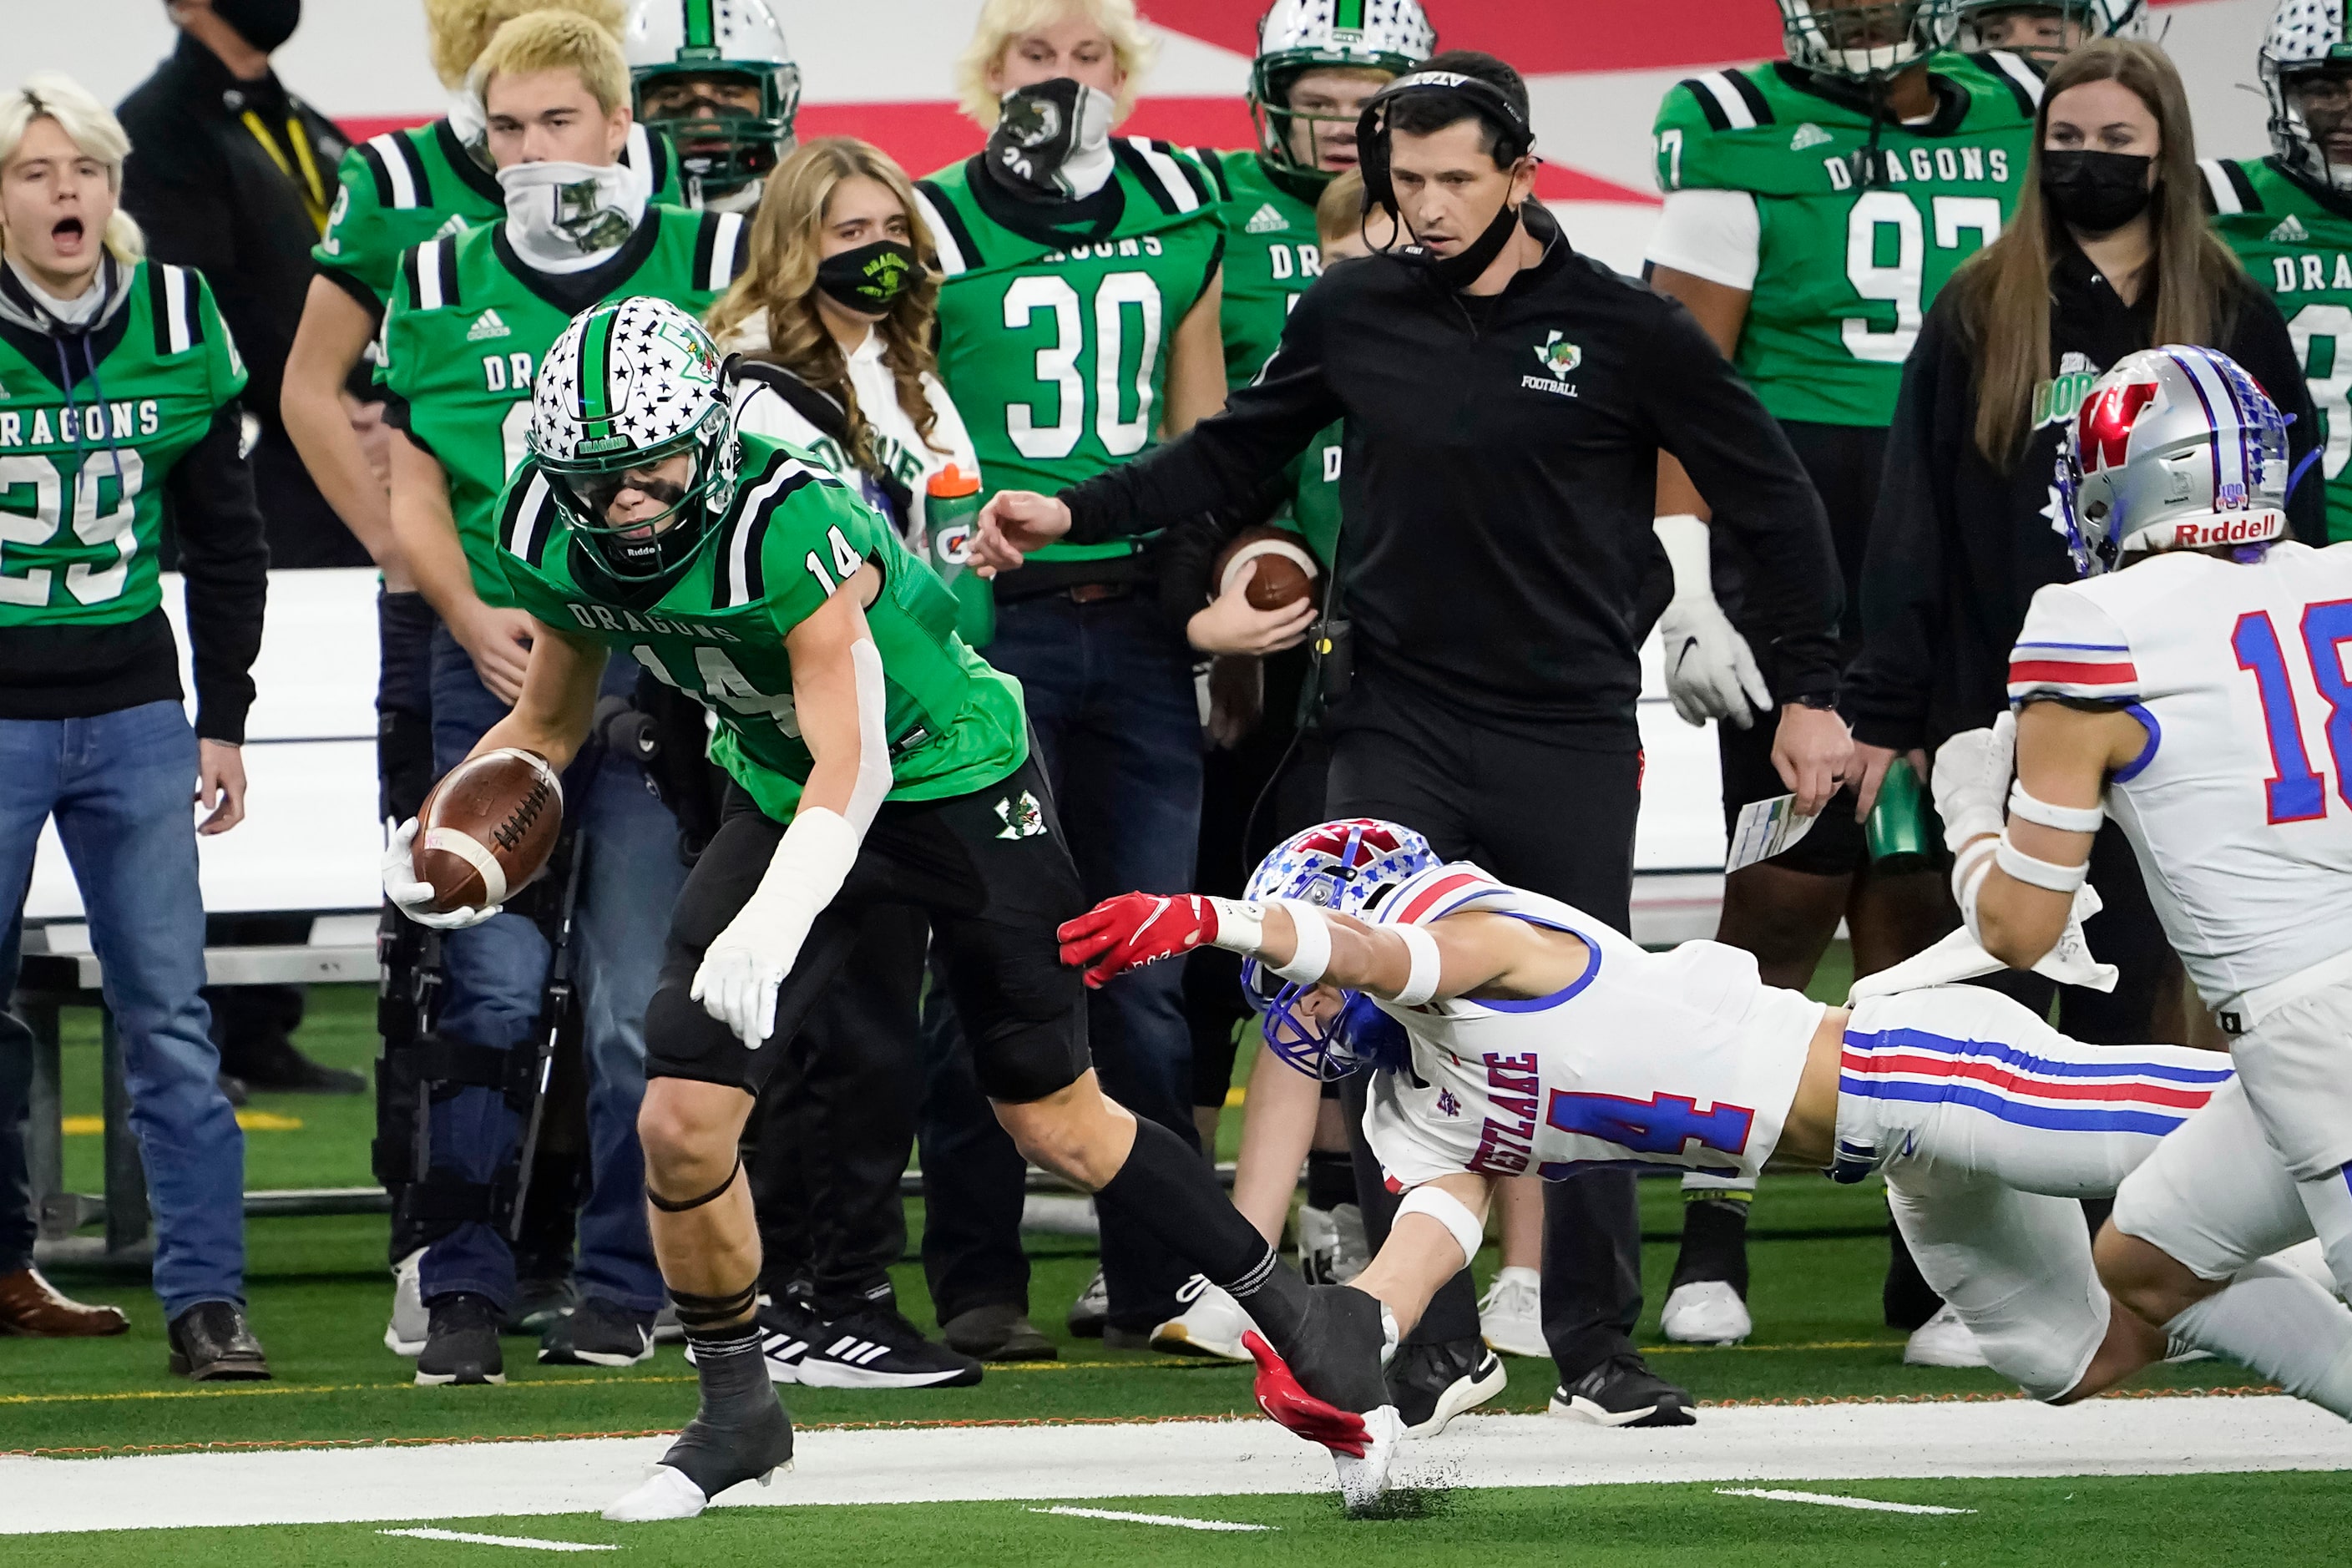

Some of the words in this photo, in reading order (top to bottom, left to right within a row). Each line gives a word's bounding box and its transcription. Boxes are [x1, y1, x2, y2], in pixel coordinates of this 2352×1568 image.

[1405, 70, 1470, 89] AT&T
[1823, 147, 2010, 191] DAGONS
[1004, 271, 1162, 458] 30
[1520, 375, 1579, 398] FOOTBALL
[578, 435, 629, 455] DRAGONS
[0, 448, 144, 607] 29
[2174, 513, 2276, 547] Riddell
[626, 544, 663, 558] Riddel
[805, 522, 864, 599] 14
[631, 644, 802, 740] 14
